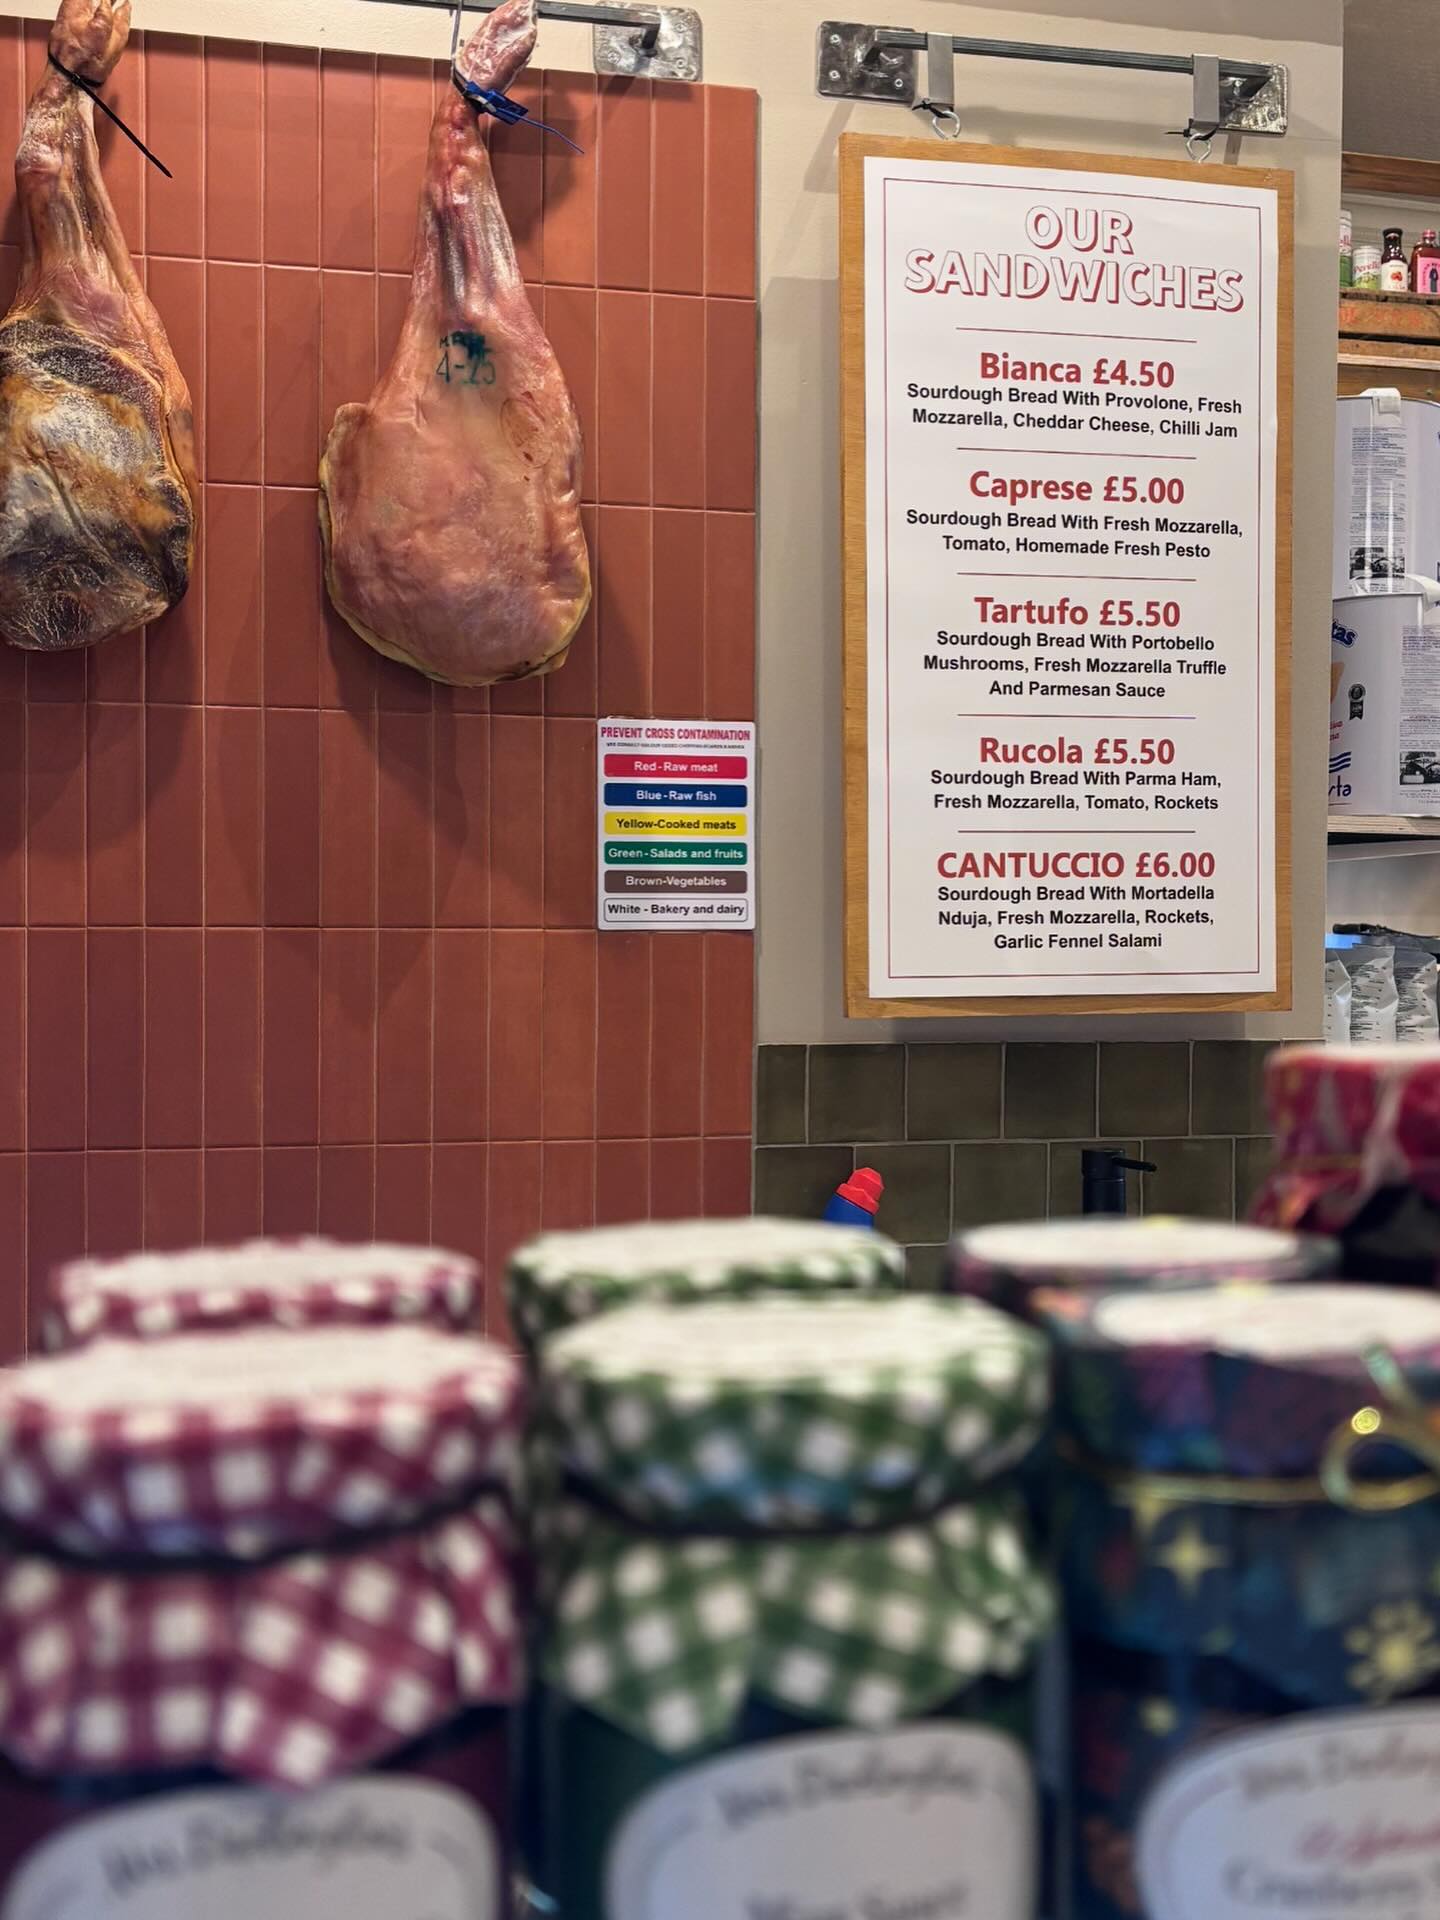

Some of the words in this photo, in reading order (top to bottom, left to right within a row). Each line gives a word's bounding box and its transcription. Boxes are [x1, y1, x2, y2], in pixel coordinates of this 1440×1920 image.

[1023, 204, 1135, 256] OUR
[903, 247, 1245, 314] SANDWICHES
[981, 352, 1081, 383] Bianca
[1093, 358, 1174, 388] £4.50
[907, 383, 1002, 405] Sourdough
[1008, 387, 1058, 404] Bread
[1062, 390, 1100, 406] With
[1105, 392, 1192, 413] Provolone,
[1198, 397, 1241, 414] Fresh
[913, 408, 1008, 429] Mozzarella,
[1013, 413, 1084, 430] Cheddar
[1089, 416, 1154, 435] Cheese,
[1159, 419, 1200, 435] Chilli
[1205, 422, 1237, 438] Jam
[970, 471, 1092, 506] Caprese
[1103, 476, 1184, 504] £5.00
[907, 509, 1002, 530] Sourdough
[1007, 512, 1056, 528] Bread
[1061, 514, 1098, 530] With
[1104, 516, 1150, 531] Fresh
[1155, 518, 1242, 537] Mozzarella,
[942, 535, 1010, 554] Tomato,
[1016, 537, 1109, 555] Homemade
[1114, 540, 1160, 556] Fresh
[1165, 542, 1211, 558] Pesto
[974, 597, 1088, 625] Tartufo
[1099, 600, 1180, 627] £5.50
[937, 630, 1031, 650] Sourdough
[1037, 632, 1085, 648] Bread
[1090, 634, 1126, 649] With
[1132, 635, 1214, 651] Portobello
[924, 655, 1029, 673] Mushrooms,
[1034, 657, 1081, 672] Fresh
[1086, 658, 1172, 673] Mozzarella
[1176, 660, 1226, 675] Truffle
[989, 680, 1023, 695] And
[1029, 681, 1111, 696] Parmesan
[1116, 682, 1165, 697] Sauce
[601, 727, 643, 738] PREVENT
[645, 728, 675, 739] CROSS
[677, 729, 751, 741] CONTAMINATION
[980, 736, 1083, 764] Rucola
[1094, 738, 1175, 765] £5.50
[691, 763, 718, 773] meat
[931, 769, 1025, 788] Sourdough
[1030, 770, 1078, 785] Bread
[1083, 771, 1120, 785] With
[1125, 771, 1176, 786] Parma
[1181, 771, 1221, 788] Ham,
[696, 791, 717, 801] fish
[934, 794, 982, 808] Fresh
[987, 794, 1079, 811] Mozzarella,
[1084, 795, 1149, 811] Tomato,
[1154, 795, 1218, 809] Rockets
[616, 819, 700, 829] Yellow-Cooked
[703, 820, 737, 830] meats
[691, 849, 712, 858] and
[715, 849, 744, 858] fruits
[937, 852, 1124, 878] CANTUCCIO
[1136, 852, 1215, 877] £6.00
[626, 876, 727, 888] Brown-Vegetables
[938, 886, 1031, 904] Sourdough
[1037, 886, 1085, 900] Bread
[1089, 886, 1126, 900] With
[1132, 885, 1214, 900] Mortadella
[608, 904, 641, 914] White
[651, 905, 690, 916] Bakery
[693, 905, 714, 913] and
[717, 905, 745, 915] dairy
[939, 911, 992, 928] Nduja,
[997, 910, 1044, 925] Fresh
[1050, 909, 1140, 926] Mozzarella,
[1145, 909, 1213, 925] Rockets,
[994, 934, 1043, 949] Garlic
[1048, 933, 1103, 948] Fennel
[1108, 933, 1162, 948] Salami
